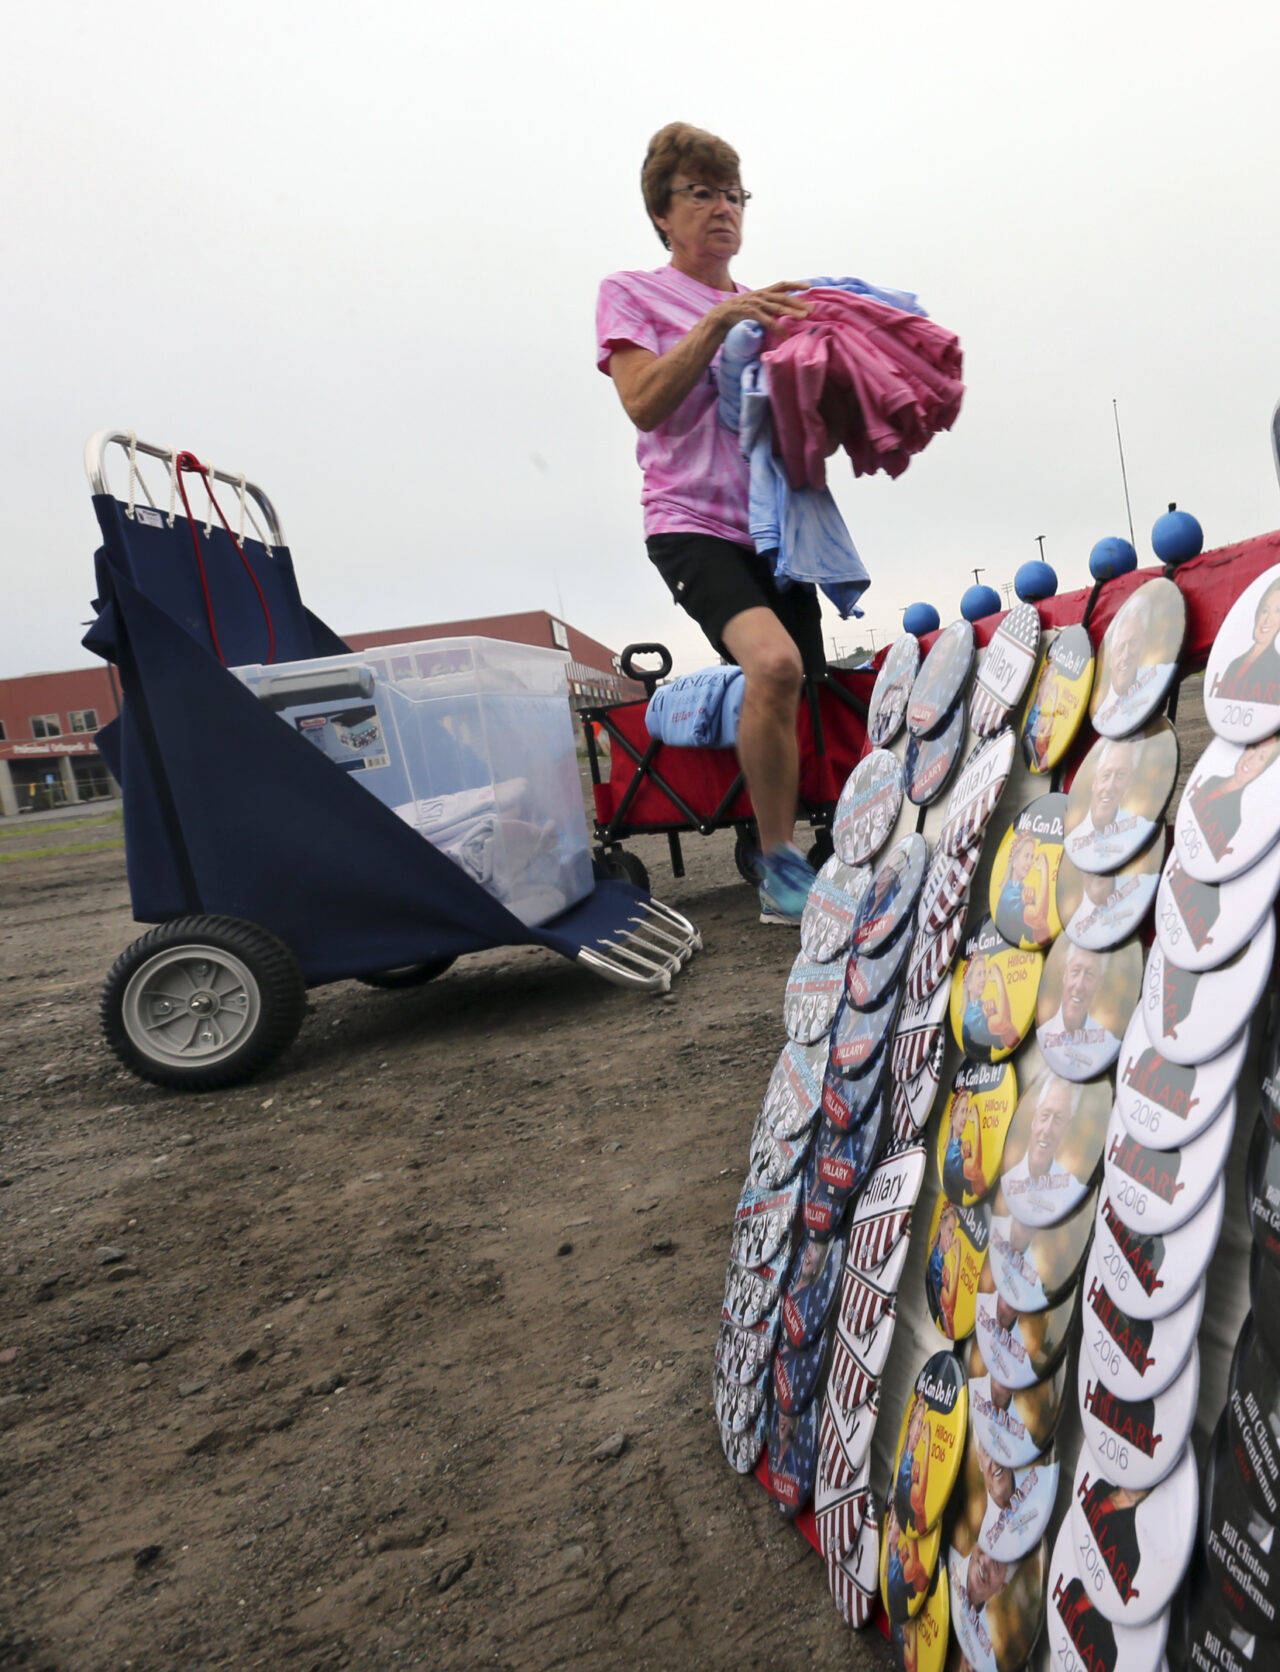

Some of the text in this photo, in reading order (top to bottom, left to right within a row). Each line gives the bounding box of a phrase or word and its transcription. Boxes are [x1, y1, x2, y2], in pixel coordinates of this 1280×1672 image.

[986, 643, 1018, 693] Hillary
[1221, 703, 1254, 727] 2016
[914, 762, 942, 793] HILLARY
[953, 753, 999, 811] Hillary
[1018, 812, 1032, 831] We
[1032, 814, 1050, 834] Can
[978, 932, 995, 950] Can
[1160, 902, 1183, 946] 2016
[1007, 952, 1036, 967] Hillary
[1007, 968, 1028, 984] 2016
[965, 1067, 979, 1086] Can
[979, 1064, 991, 1083] Do
[1121, 1055, 1200, 1120] HILLARY
[981, 1116, 999, 1129] 2016
[984, 1100, 1008, 1113] Hillary
[1129, 1099, 1162, 1133] 2016
[822, 1163, 848, 1180] HILLARY
[1107, 1133, 1185, 1205] HILLARY
[860, 1171, 908, 1209] Hillary
[1116, 1179, 1149, 1216] 2016
[1251, 1196, 1270, 1223] First
[1103, 1243, 1130, 1292] 2016
[1086, 1275, 1156, 1378] HILLARY
[1093, 1330, 1121, 1376] 2016
[924, 1373, 937, 1399] Can
[936, 1379, 946, 1400] Do
[935, 1424, 956, 1448] Hillary
[1084, 1379, 1163, 1459] HILLARY
[1243, 1391, 1280, 1481] Bill Clinton
[931, 1443, 946, 1462] 2016
[1098, 1430, 1130, 1470] 2016
[1230, 1389, 1279, 1513] First Gentleman
[1077, 1472, 1140, 1606] HILLARY
[1221, 1520, 1270, 1588] Bill Clinton
[1079, 1533, 1106, 1592] 2016
[1207, 1529, 1276, 1621] First Gentleman
[1204, 1629, 1243, 1672] Bill Clint
